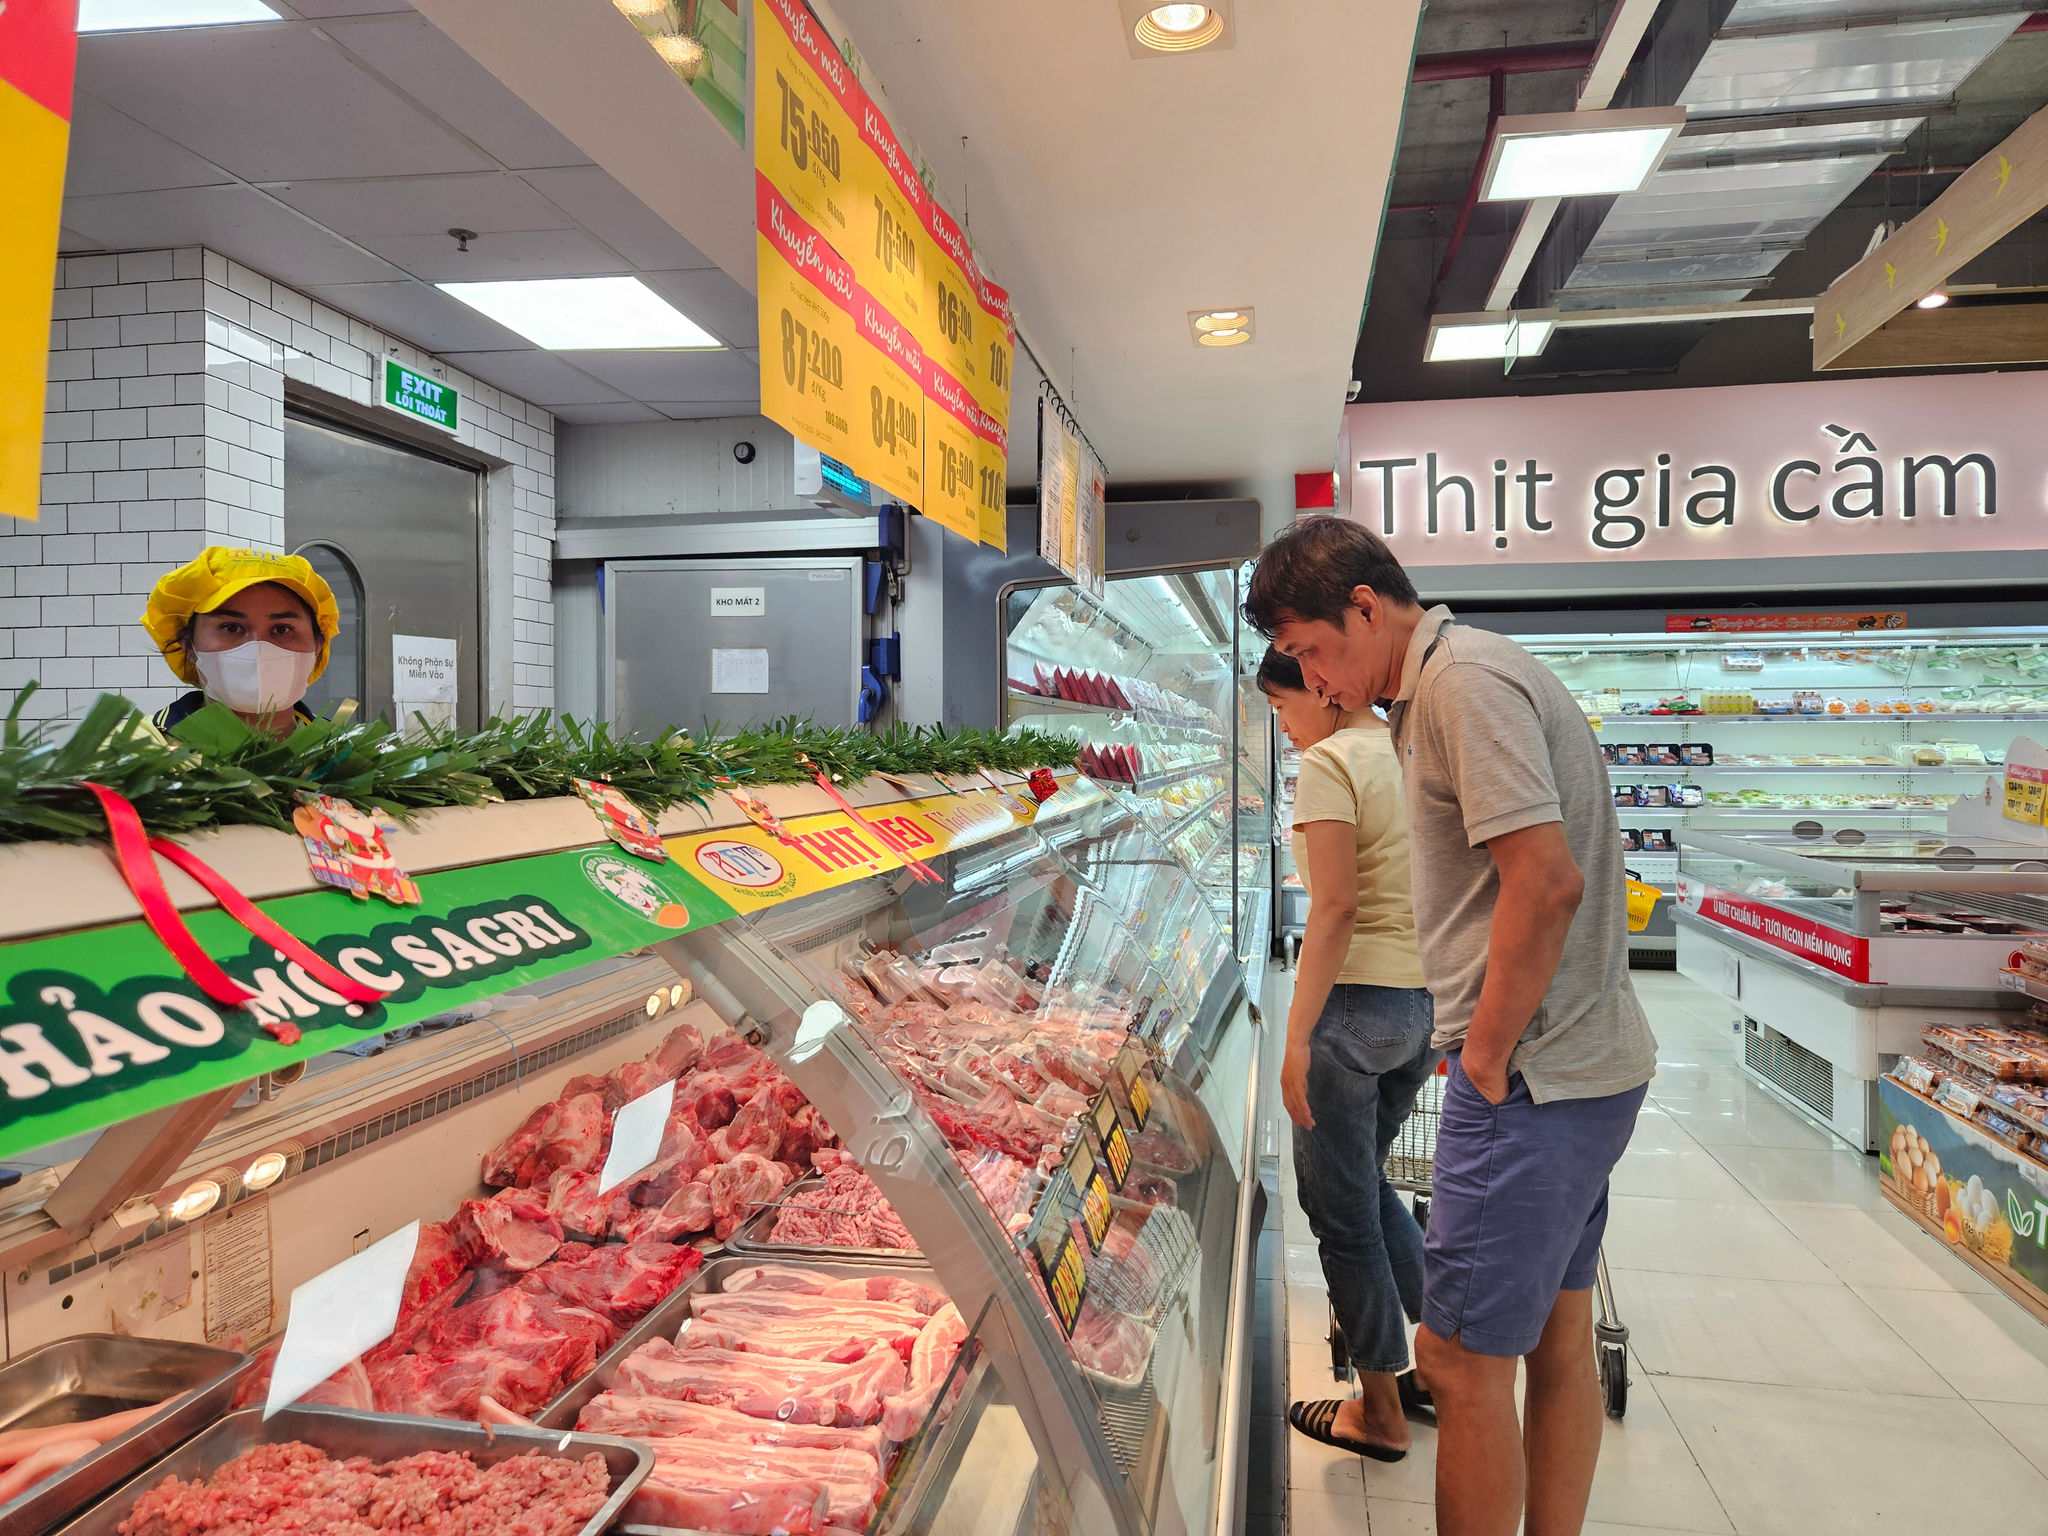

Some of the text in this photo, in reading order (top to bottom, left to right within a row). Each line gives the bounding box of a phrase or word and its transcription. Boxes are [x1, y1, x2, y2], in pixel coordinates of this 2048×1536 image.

[821, 50, 846, 95] mãi
[776, 67, 841, 181] 75.650
[865, 106, 902, 176] Khuyến
[771, 198, 824, 274] Khuyến
[825, 265, 853, 300] mãi
[874, 193, 915, 276] 76.500
[864, 303, 904, 355] Khuyến
[905, 348, 922, 375] mãi
[937, 280, 973, 345] 86.700
[781, 308, 843, 395] 87.200
[395, 390, 447, 422] LỐI THOÁT
[401, 371, 443, 403] EXIT
[933, 371, 966, 413] Khuyến
[871, 384, 917, 456] 84.800
[938, 440, 974, 499] 76.500
[1358, 423, 1997, 550] Thịt gia cầm
[716, 596, 760, 606] KHO MÁT 2
[398, 656, 423, 667] Không
[429, 670, 444, 679] Vào
[778, 826, 882, 873] THỊT
[391, 905, 577, 978] SAGRI
[1718, 901, 1730, 918] MÁT
[1782, 924, 1803, 947] NGON
[1824, 941, 1852, 967] MỌNG
